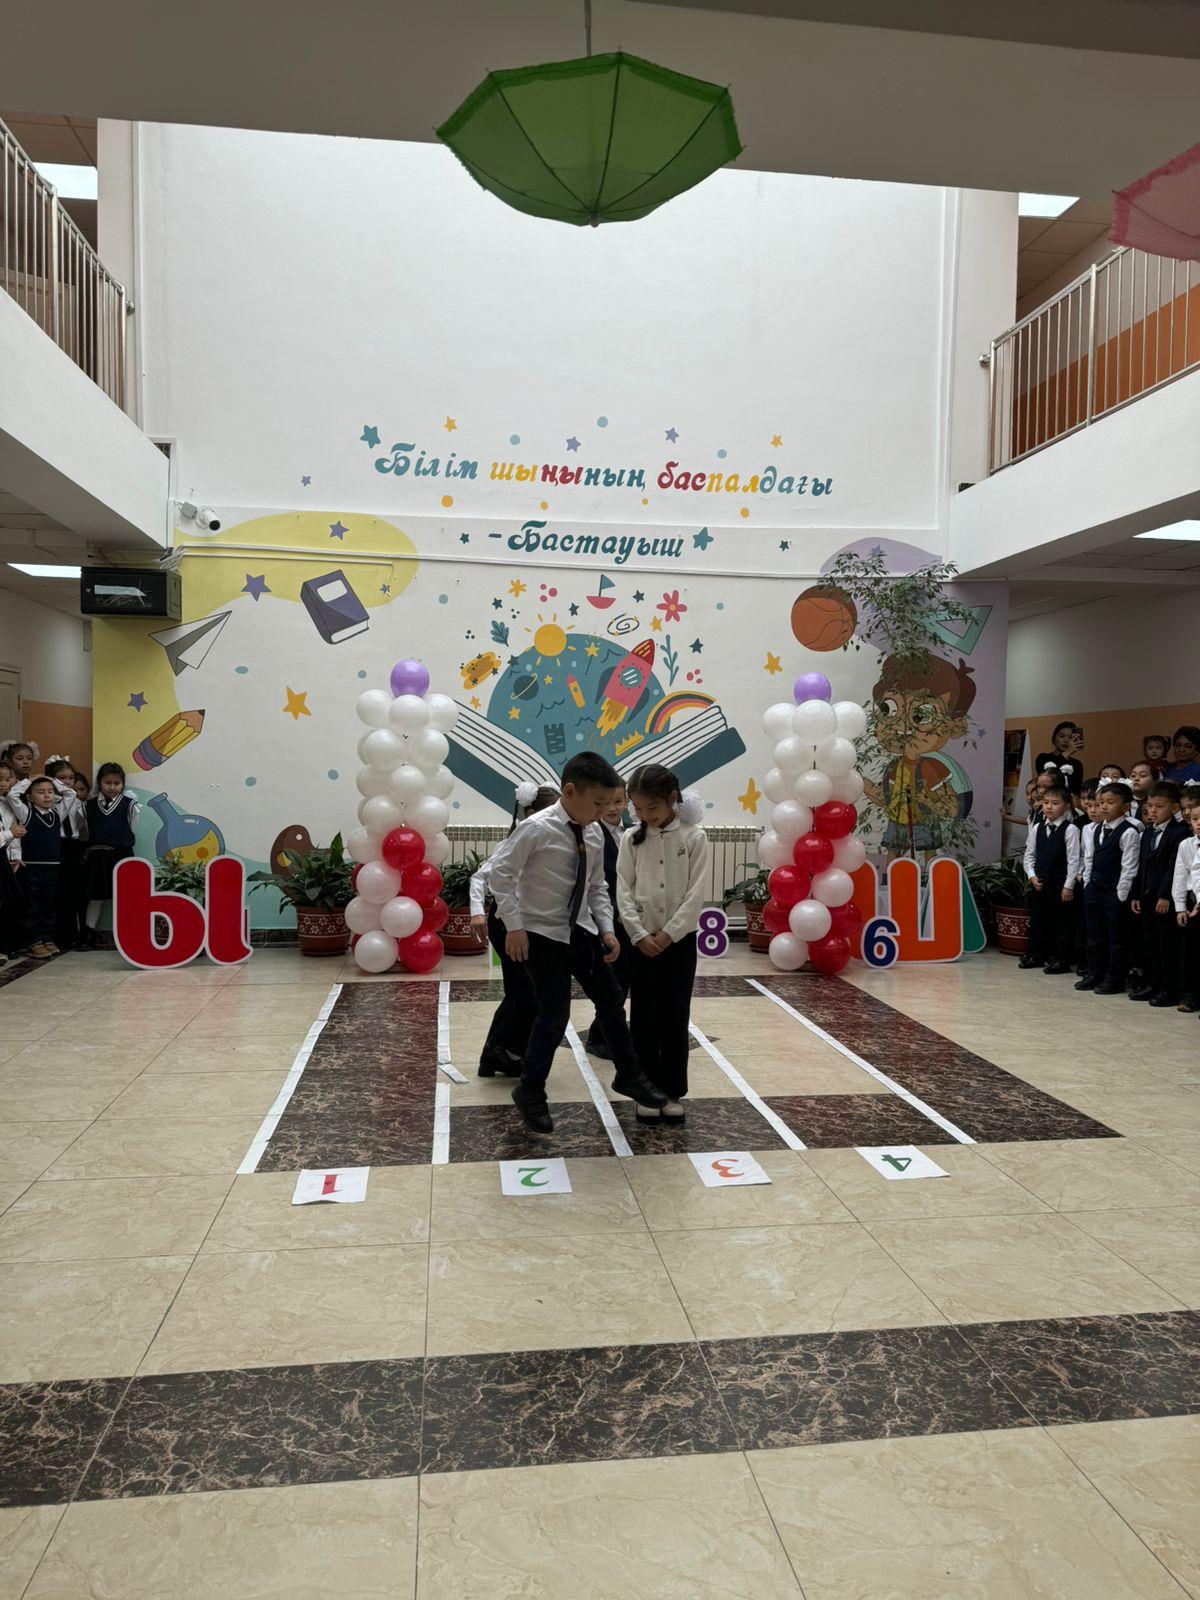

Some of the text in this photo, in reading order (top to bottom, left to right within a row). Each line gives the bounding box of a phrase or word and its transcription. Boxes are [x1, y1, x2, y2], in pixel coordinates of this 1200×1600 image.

[374, 442, 833, 497] Білім шыңының баспалдағы
[697, 907, 729, 958] 8
[861, 915, 900, 969] 6
[711, 1158, 744, 1178] 3
[880, 1154, 913, 1172] 4
[317, 1173, 344, 1196] 1
[517, 1166, 549, 1188] 2
